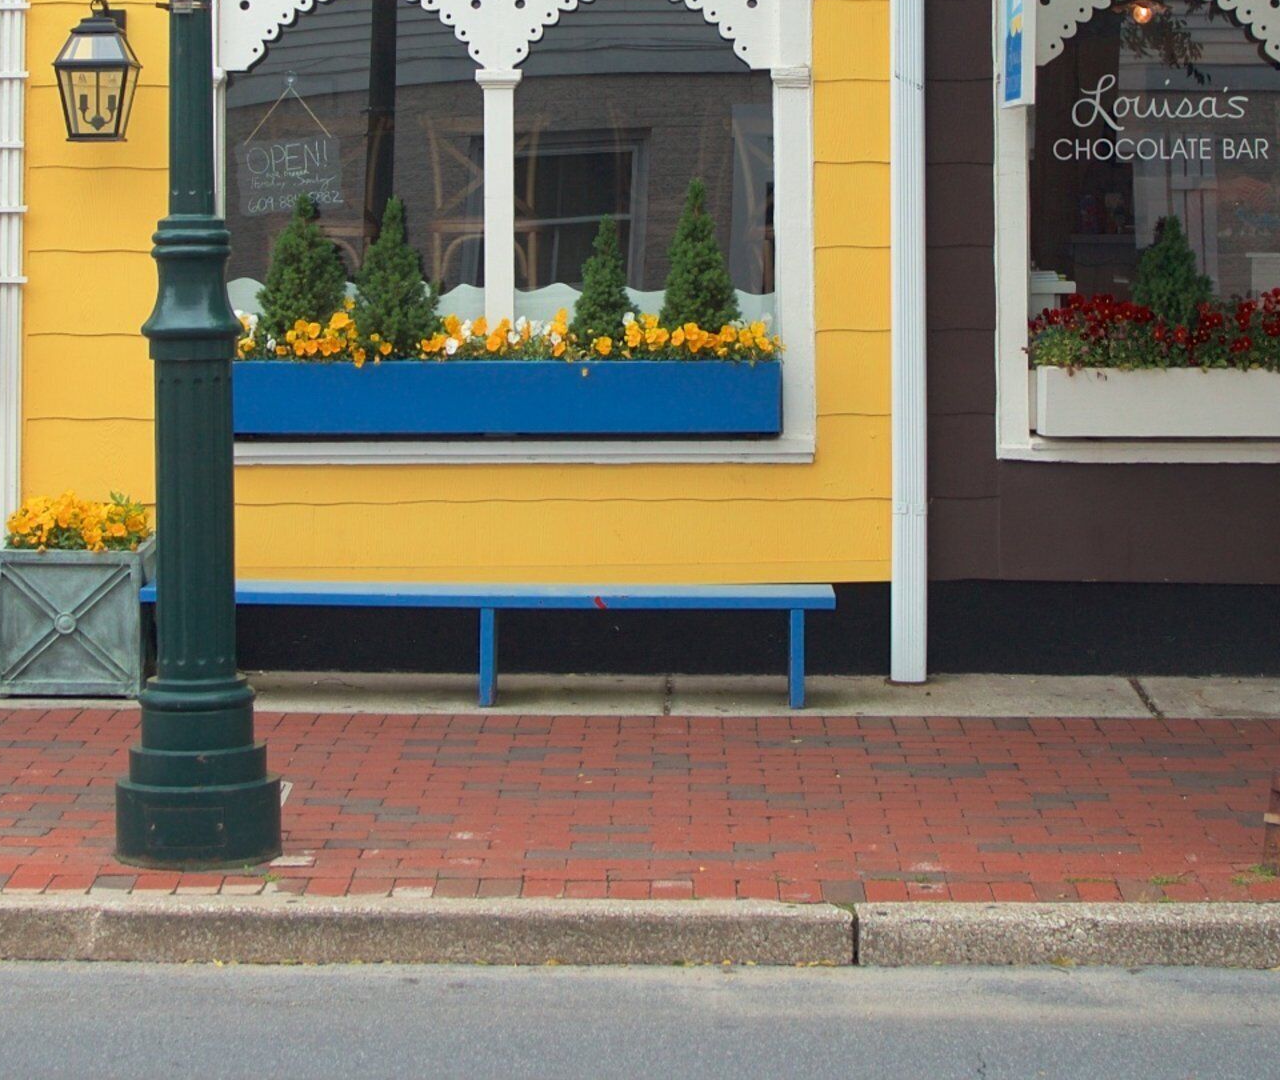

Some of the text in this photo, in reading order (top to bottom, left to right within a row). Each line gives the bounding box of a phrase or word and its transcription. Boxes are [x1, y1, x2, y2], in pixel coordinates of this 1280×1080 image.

[1071, 73, 1250, 131] Louisa's
[246, 139, 328, 175] OPEN!
[1052, 137, 1269, 161] CHOCOLATE BAR
